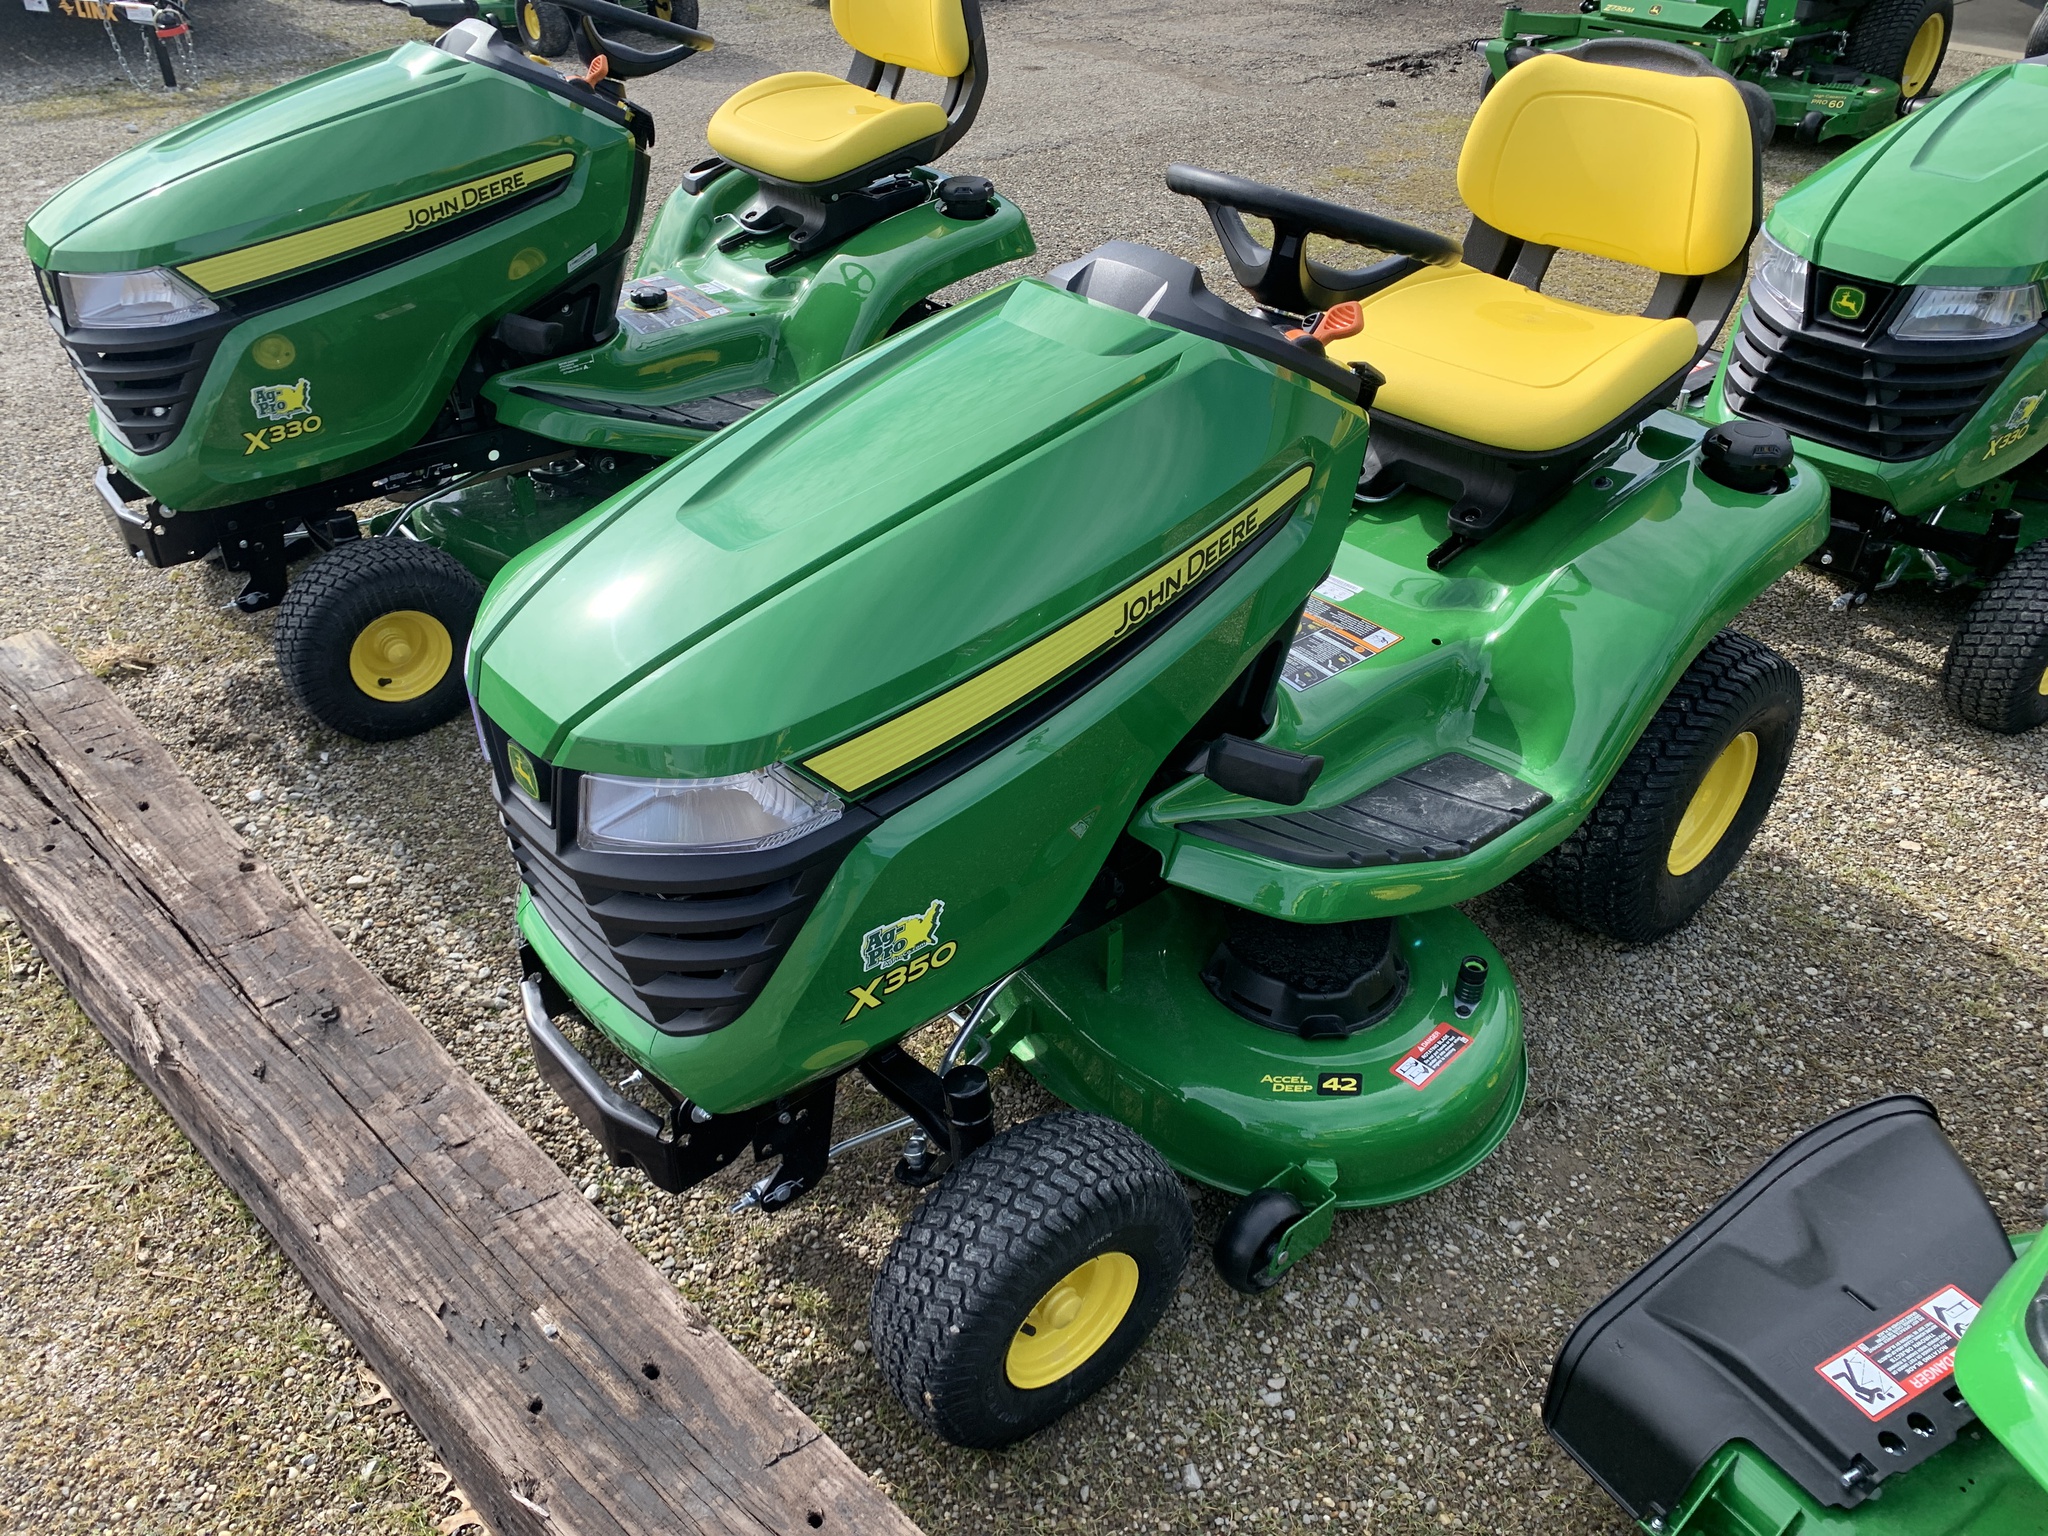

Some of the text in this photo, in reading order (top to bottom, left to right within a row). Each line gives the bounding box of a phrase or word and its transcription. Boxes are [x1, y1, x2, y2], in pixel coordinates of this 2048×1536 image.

[1828, 100, 1844, 108] 60
[404, 172, 526, 231] JOHN DEERE
[260, 401, 285, 415] Pro
[243, 415, 322, 456] X330
[1982, 424, 2030, 461] X330
[1114, 507, 1259, 636] JOHN DEERE
[866, 924, 906, 952] Ag-
[867, 939, 907, 967] Pro
[842, 940, 957, 1022] X350
[1420, 1030, 1441, 1048] DANGER
[1261, 1075, 1308, 1084] ACCEL
[1272, 1084, 1313, 1093] DEEP
[1322, 1077, 1358, 1091] 42
[1888, 1332, 1935, 1363] THROWN OBJECTS
[1904, 1343, 1948, 1375] ROTATING BLADE
[1909, 1355, 1954, 1389] DANGER
